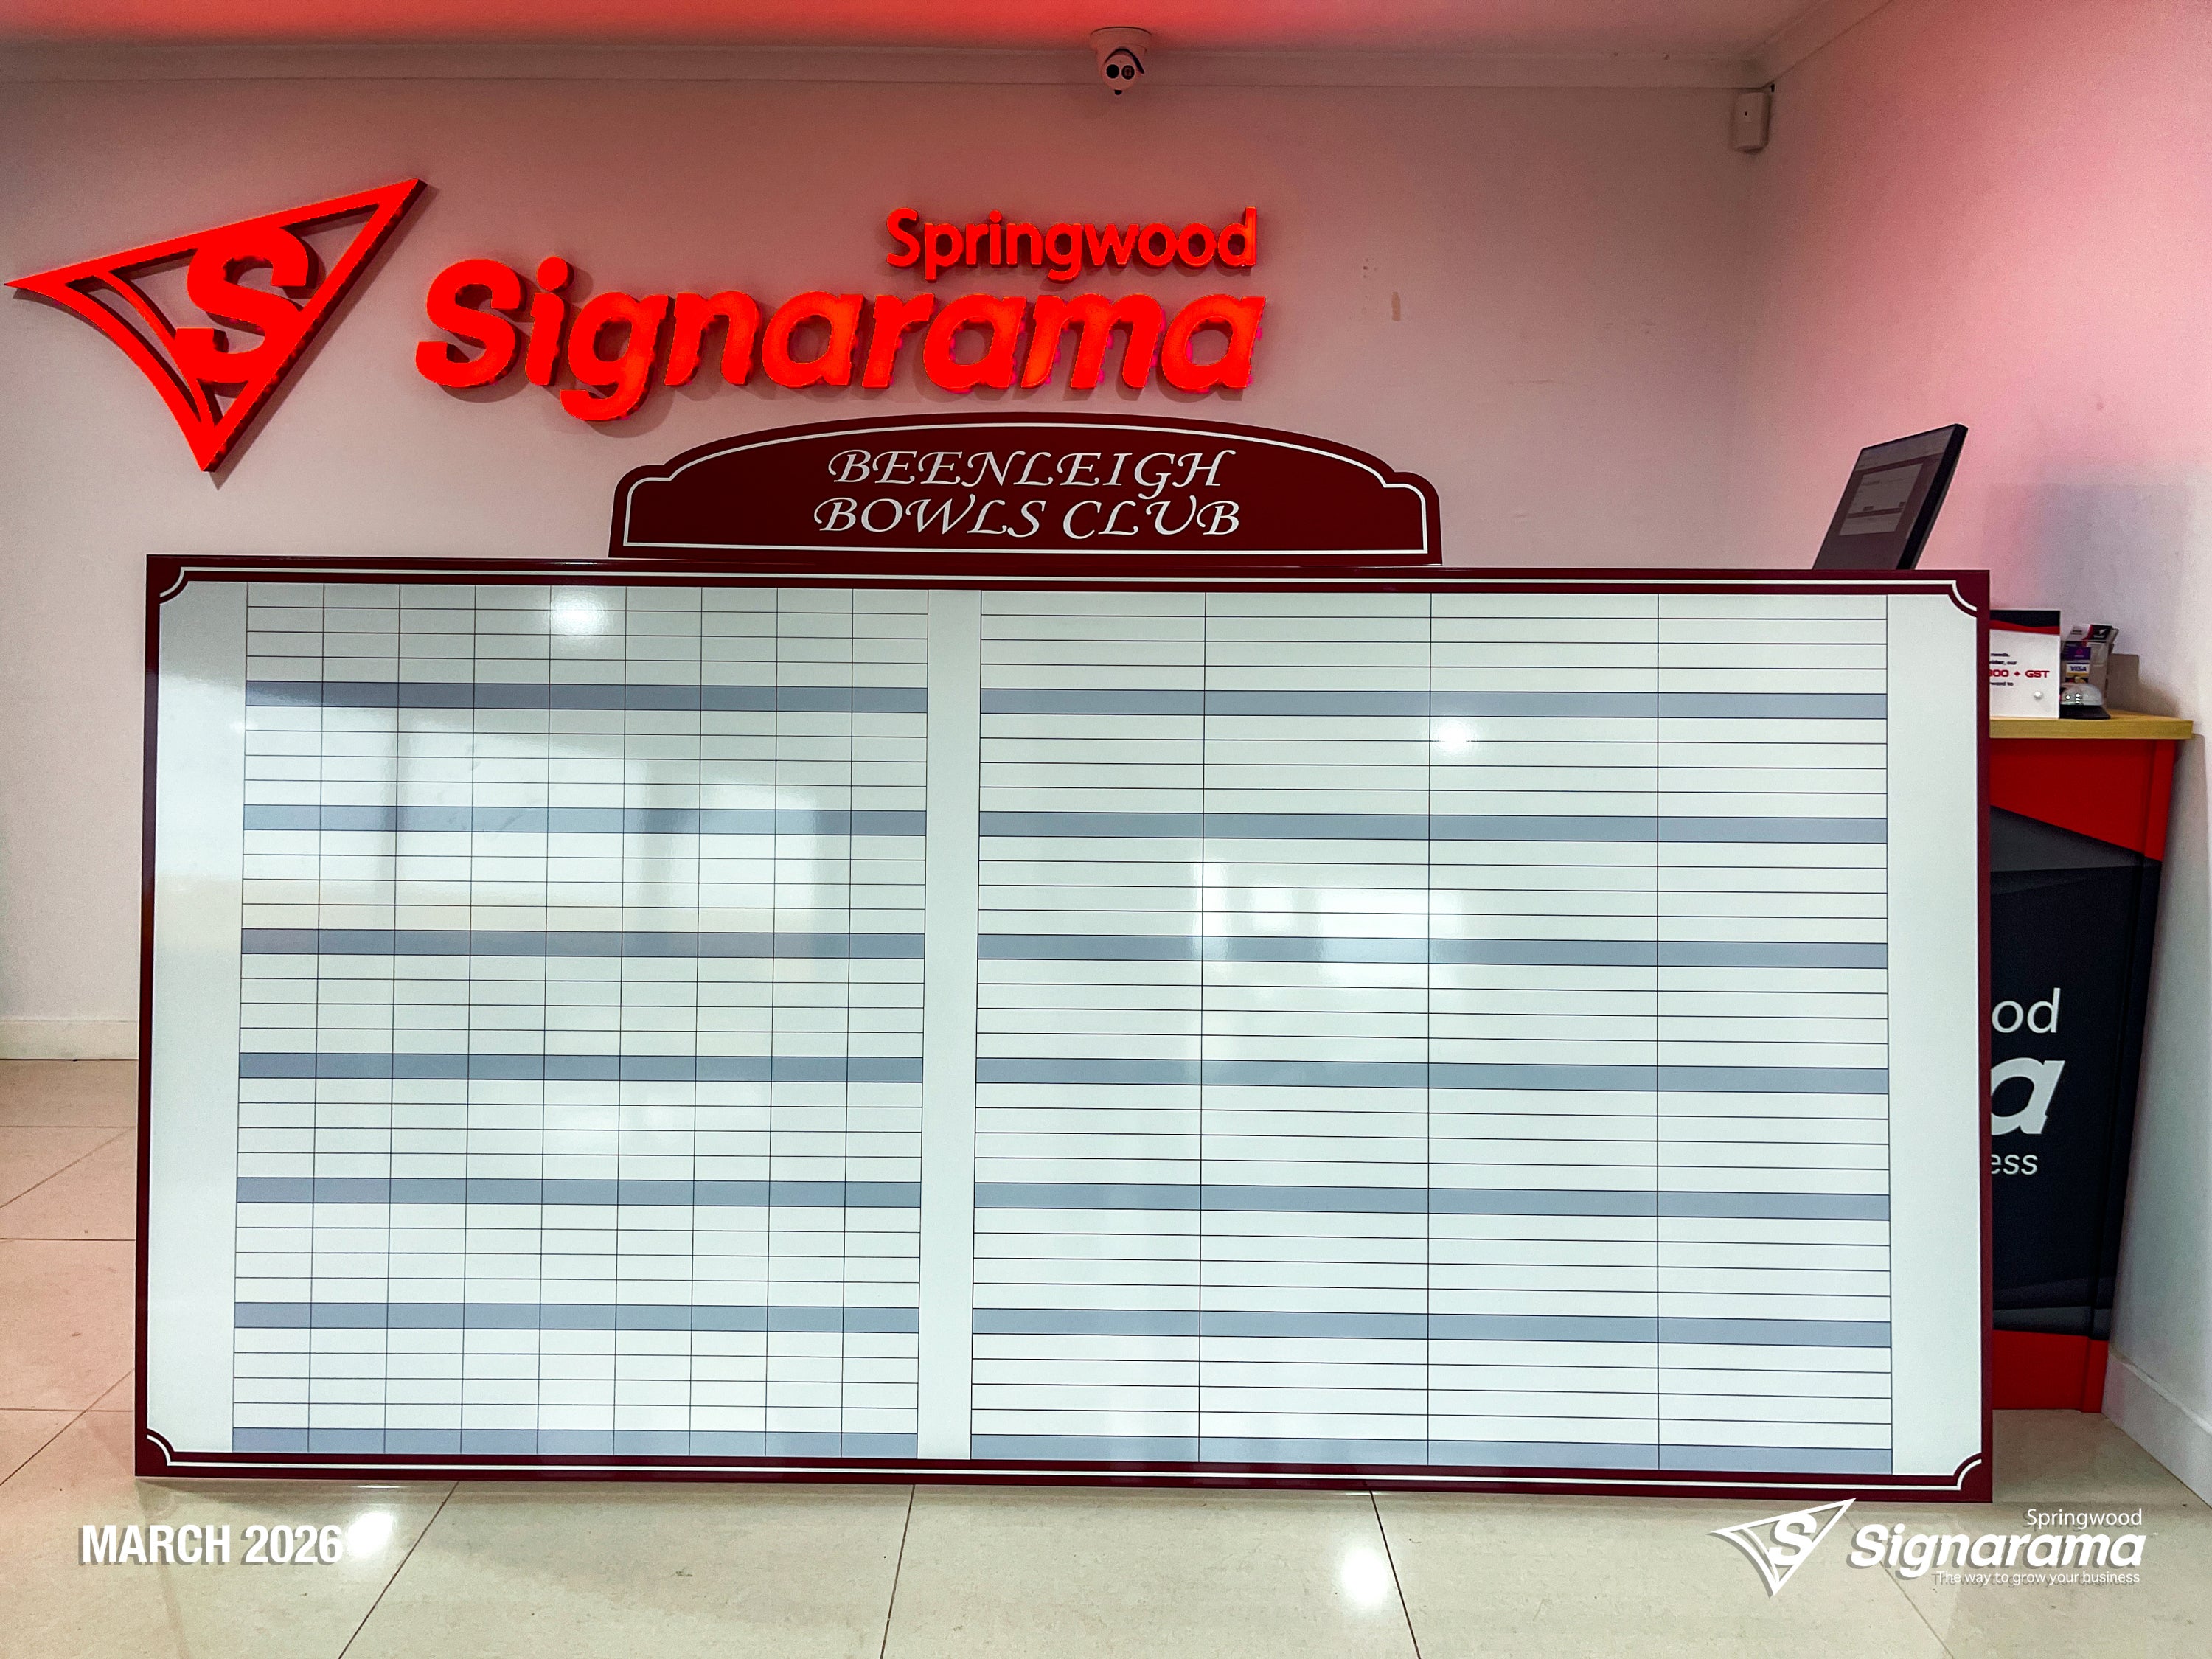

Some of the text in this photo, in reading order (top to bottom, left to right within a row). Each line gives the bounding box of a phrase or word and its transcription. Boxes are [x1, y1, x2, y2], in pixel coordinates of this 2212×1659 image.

[886, 207, 1258, 282] Springwood
[415, 255, 1267, 422] Signarama
[828, 449, 1237, 501] BEENLEIGH
[813, 494, 1240, 540] BOWLS CLUB
[2025, 669, 2050, 678] GST
[1991, 987, 2061, 1034] od
[1990, 1057, 2065, 1135] a
[1990, 1153, 2038, 1175] ess
